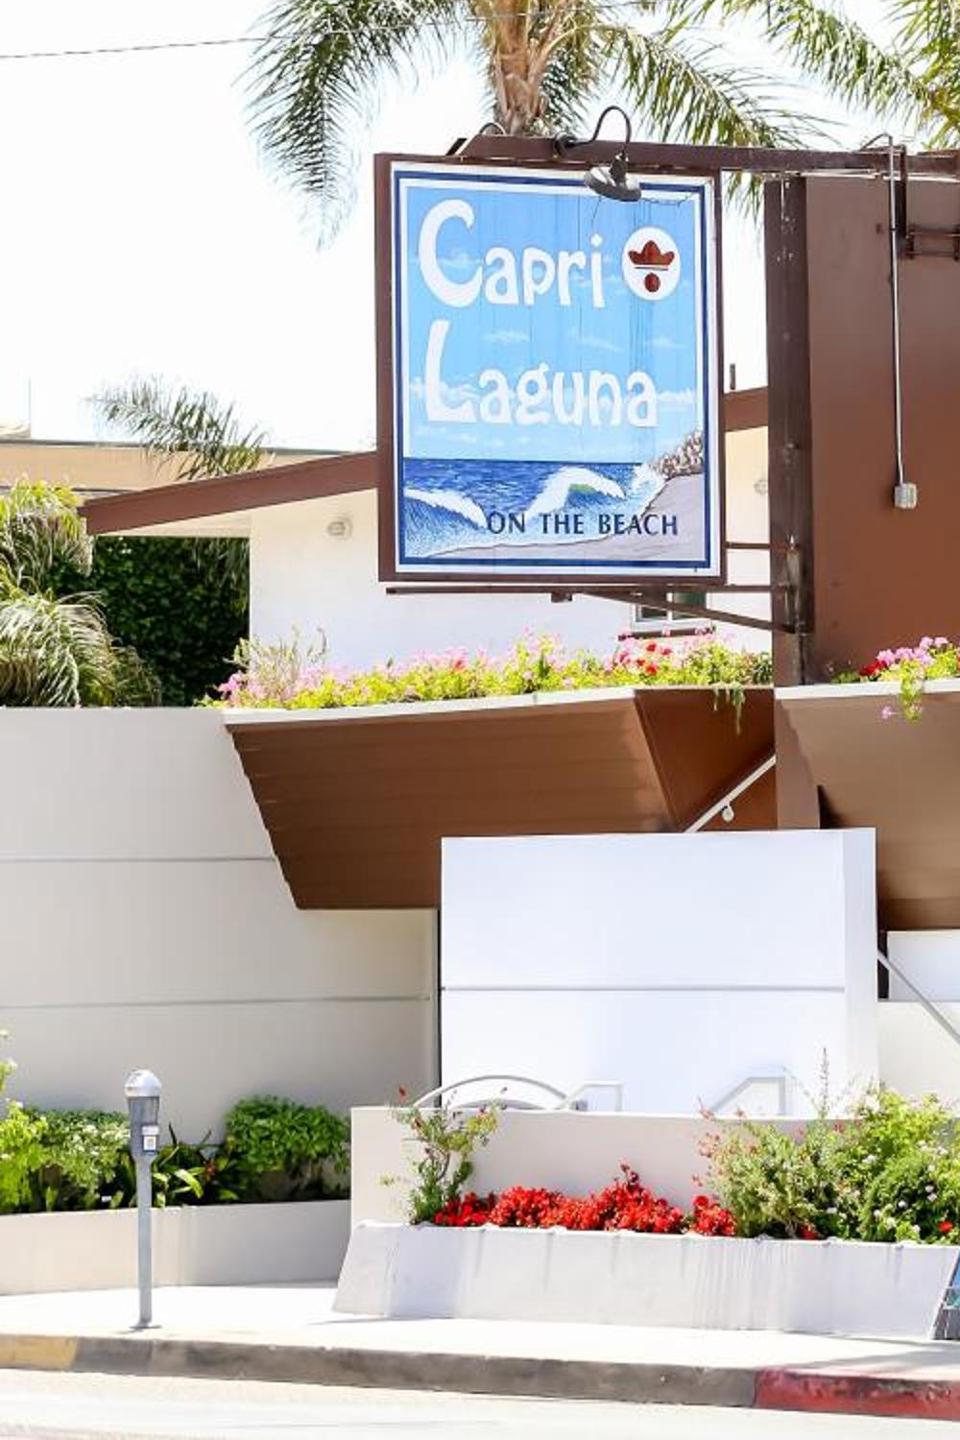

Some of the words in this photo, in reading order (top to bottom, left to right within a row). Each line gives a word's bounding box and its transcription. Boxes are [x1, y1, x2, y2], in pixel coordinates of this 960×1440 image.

[418, 198, 606, 308] Capri
[425, 319, 658, 427] Laguna
[487, 511, 526, 535] ON
[541, 512, 585, 535] THE
[599, 512, 679, 536] BEACH
